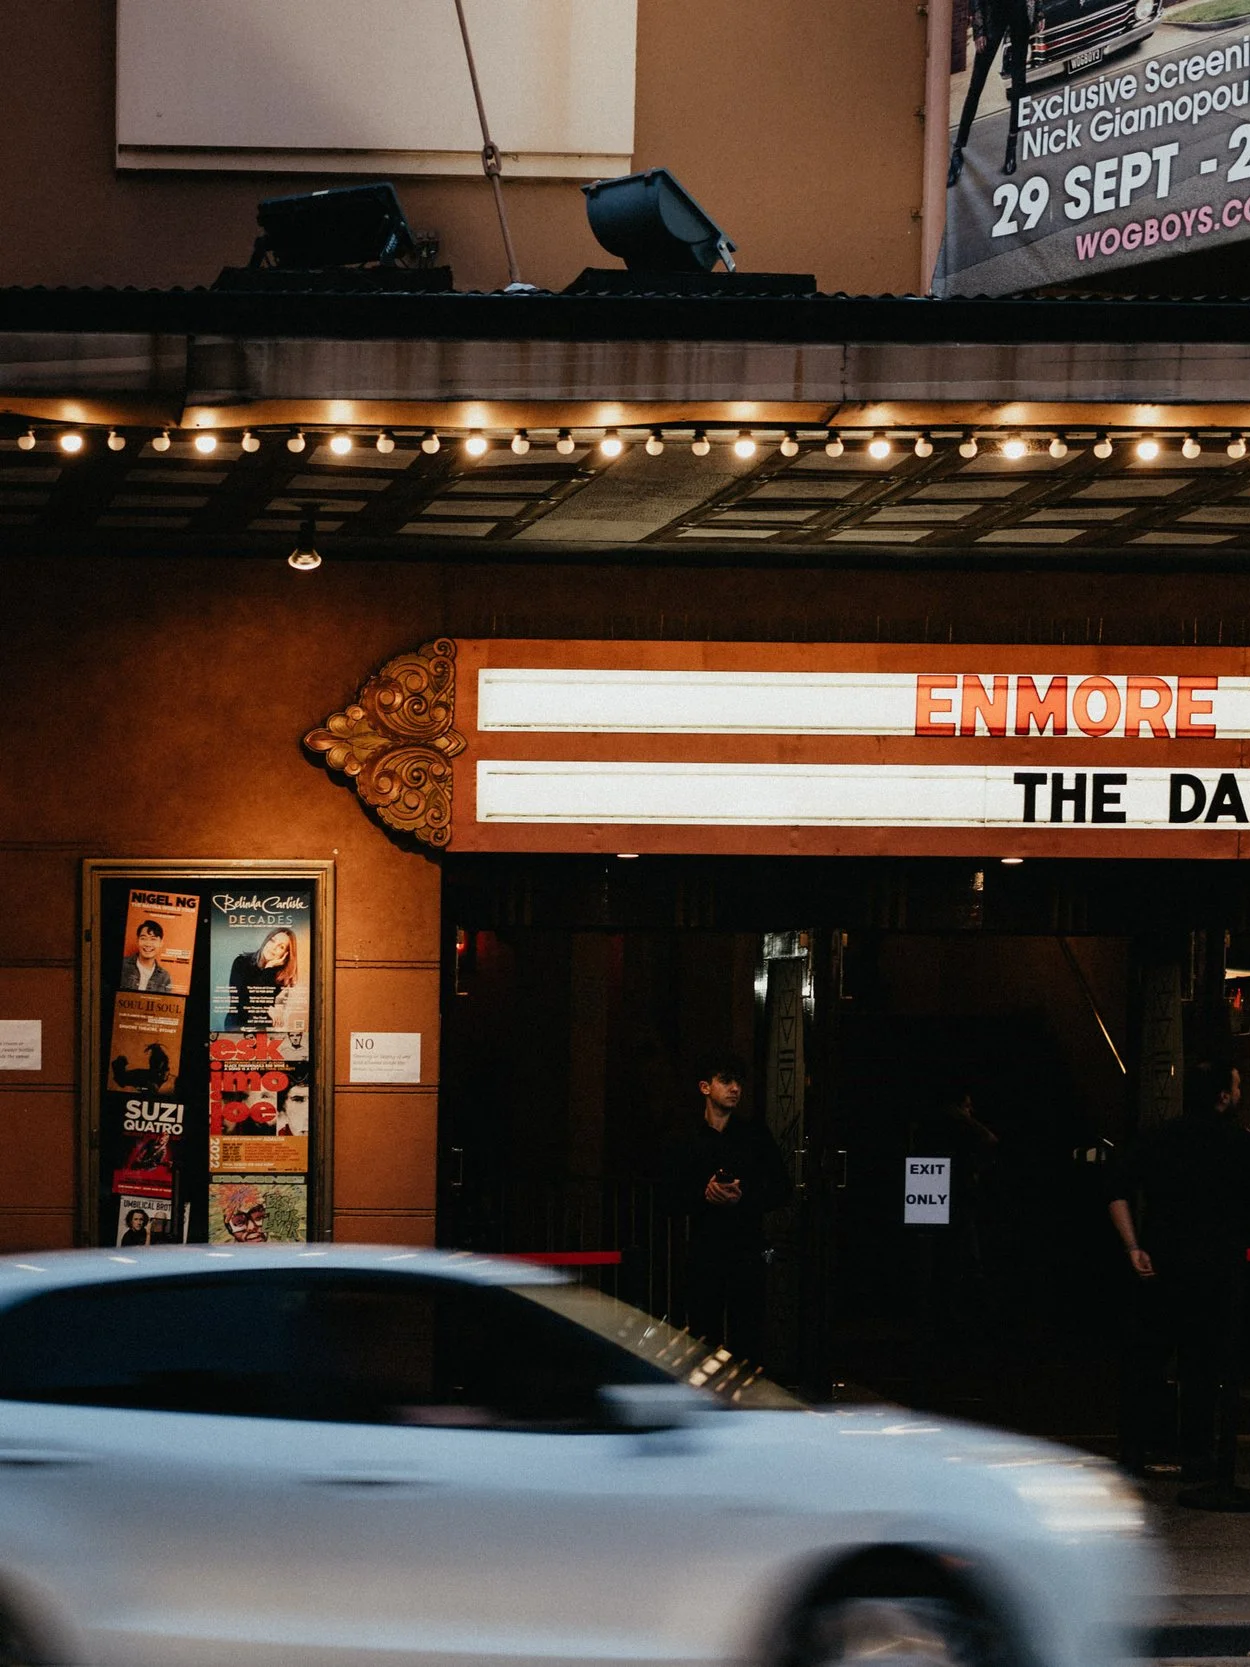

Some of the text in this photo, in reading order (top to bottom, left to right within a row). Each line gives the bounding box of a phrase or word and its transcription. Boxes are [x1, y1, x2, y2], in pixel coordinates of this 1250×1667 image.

[1017, 74, 1137, 130] Exclusive
[1021, 117, 1081, 161] Nick
[990, 177, 1049, 237] 29
[1063, 142, 1180, 221] SEPT
[1200, 157, 1217, 176] -
[914, 674, 1219, 739] ENMORE
[1013, 772, 1128, 824] THE
[131, 892, 173, 906] NIGEL
[175, 897, 197, 908] NG
[212, 894, 262, 914] Belinda
[261, 896, 309, 914] Carlisle
[228, 915, 293, 925] DECADES
[118, 999, 143, 1010] SOUL
[156, 1003, 182, 1014] SOUL
[355, 1038, 375, 1050] NO
[124, 1100, 185, 1123] SUZI
[123, 1119, 183, 1135] QUATRO
[210, 1138, 220, 1169] 2022
[910, 1164, 945, 1175] EXIT
[156, 1202, 173, 1212] BROT
[905, 1193, 948, 1205] ONLY
